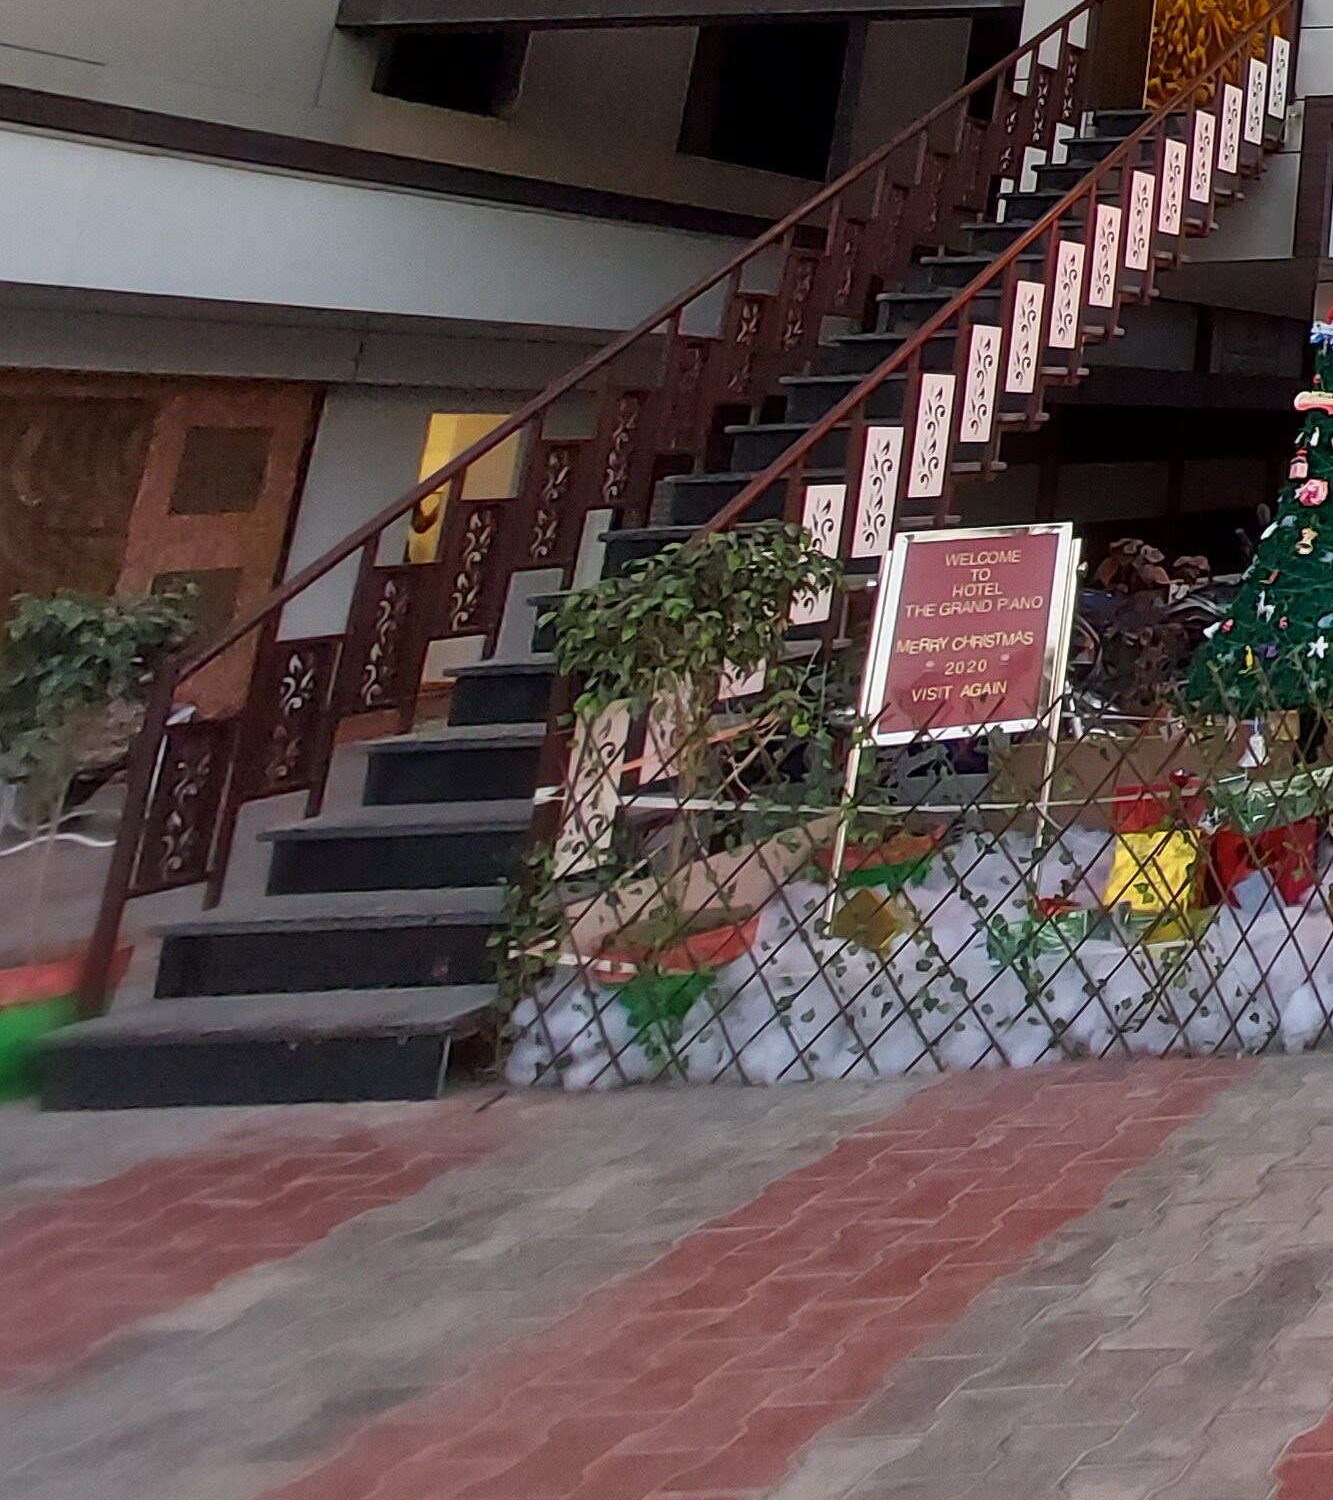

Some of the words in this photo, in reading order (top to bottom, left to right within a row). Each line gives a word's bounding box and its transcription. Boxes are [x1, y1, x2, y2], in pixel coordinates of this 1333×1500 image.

[944, 550, 1022, 566] WELCOME
[970, 568, 991, 582] TO
[952, 583, 1003, 597] HOTEL
[905, 603, 936, 618] THE
[939, 599, 993, 615] GRAND
[896, 637, 949, 655] MERRY
[951, 630, 1034, 652] CHRISTMAS
[944, 659, 988, 675] 2020
[911, 685, 953, 702] VISIT
[960, 680, 1007, 698] AGAIN
